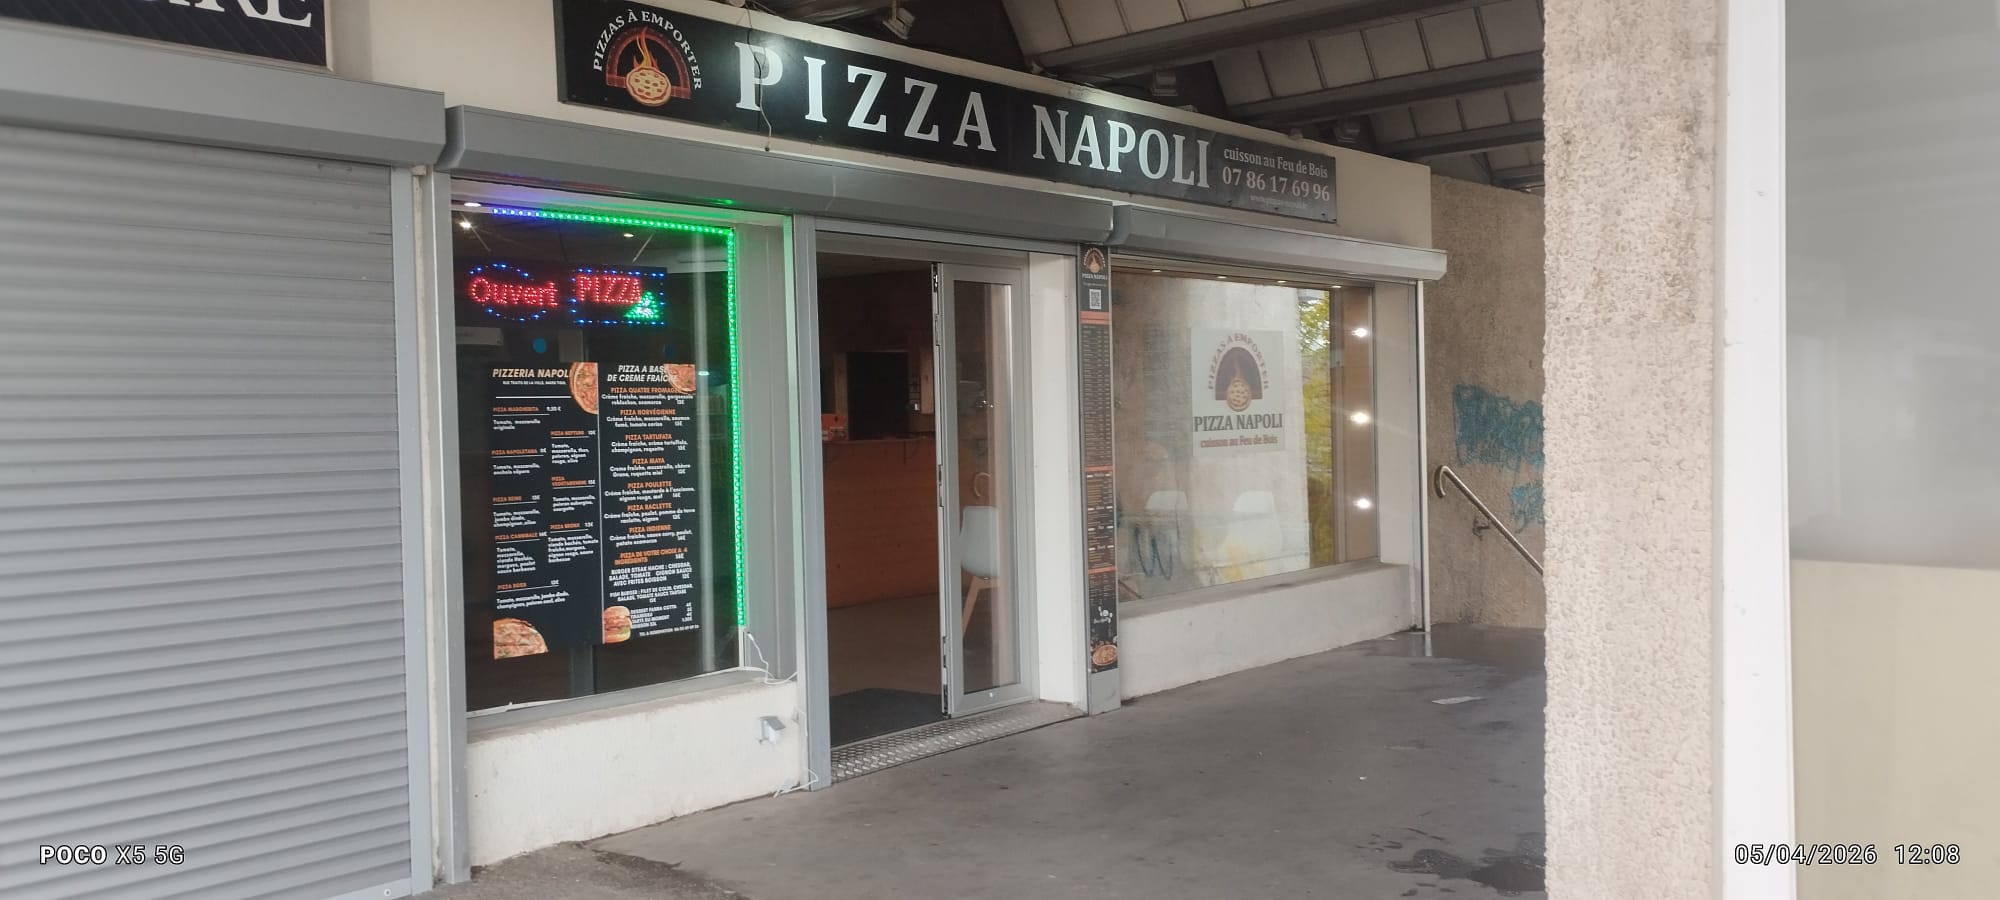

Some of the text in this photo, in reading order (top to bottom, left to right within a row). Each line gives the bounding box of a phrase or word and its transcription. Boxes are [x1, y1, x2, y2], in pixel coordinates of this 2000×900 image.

[593, 8, 702, 90] PIZZAS À EMPORTER
[734, 41, 1211, 189] PIZZA NAPOLI
[1223, 147, 1328, 178] cuisson au Feu de Bois
[1222, 166, 1330, 201] 07 86 17 69 96
[471, 277, 559, 307] Ouvert
[576, 275, 641, 304] PIZZA
[492, 368, 535, 378] PIZZERIA
[1193, 413, 1283, 432] PIZZA NAPOLI
[1200, 434, 1278, 448] cuisson au Feu de Bois
